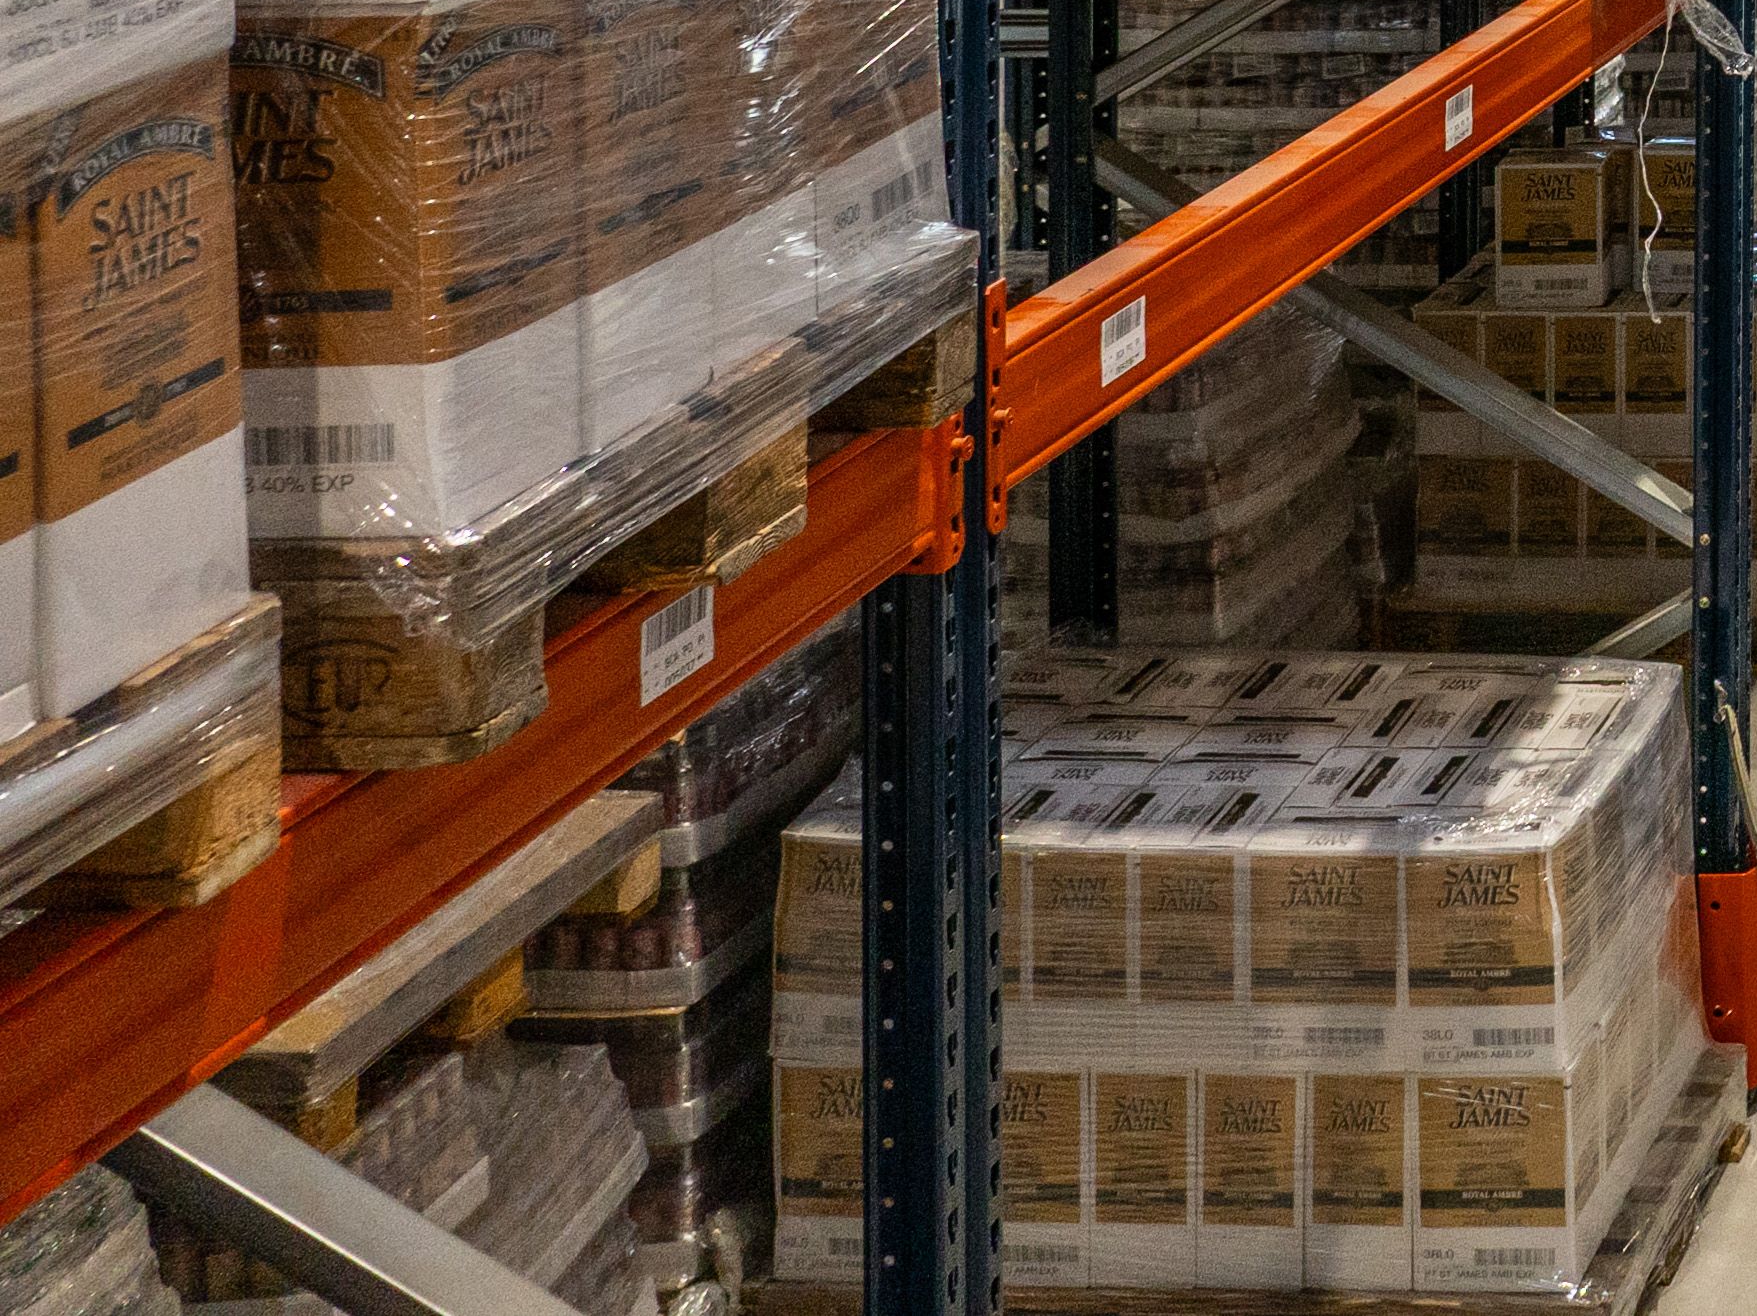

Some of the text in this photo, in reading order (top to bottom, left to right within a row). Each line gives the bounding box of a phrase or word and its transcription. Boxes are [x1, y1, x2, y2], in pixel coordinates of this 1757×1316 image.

[446, 36, 500, 80] ROYAL
[73, 134, 131, 189] ROYAL
[1527, 174, 1572, 188] SAINT
[1521, 187, 1575, 201] JAMES
[92, 175, 195, 251] SAINT
[84, 219, 201, 311] JAMES
[311, 475, 354, 493] EXP
[1445, 864, 1517, 884] SAINT
[1282, 886, 1363, 910] JAMES
[1438, 885, 1519, 908] JAMES
[1456, 1085, 1529, 1107] SAINT
[1450, 1108, 1530, 1129] JAMES
